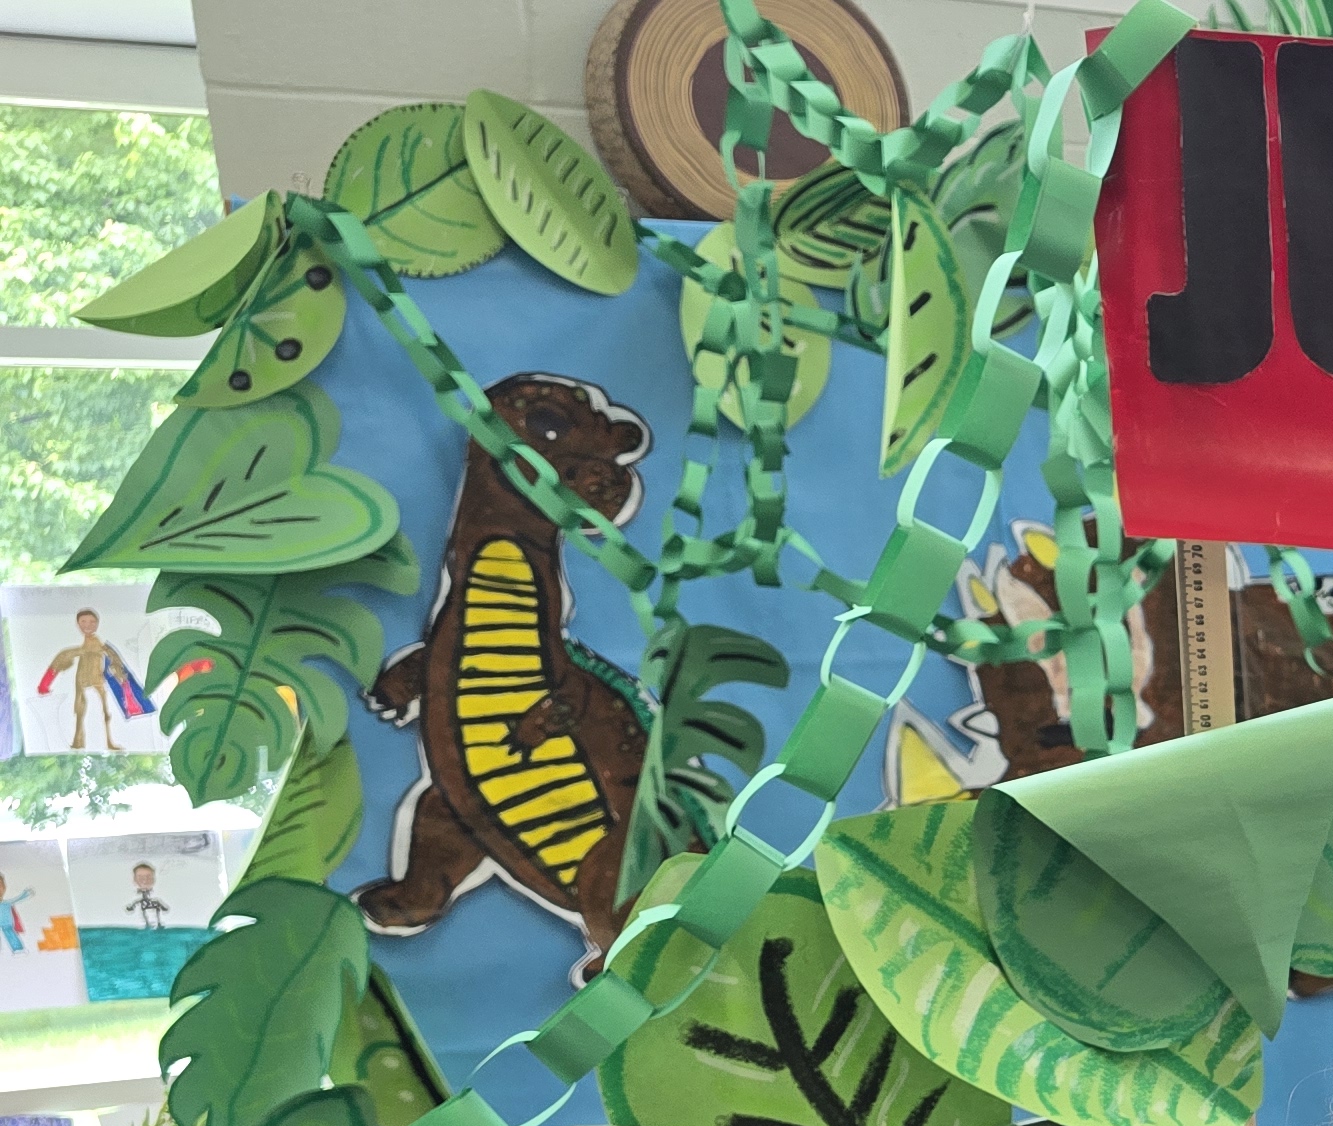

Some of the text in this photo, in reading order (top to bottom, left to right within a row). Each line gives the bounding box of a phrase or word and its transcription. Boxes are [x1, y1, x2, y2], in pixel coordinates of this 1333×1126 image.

[1191, 544, 1211, 728] 60 61 62 63 64 65 66 67 68 69 70
